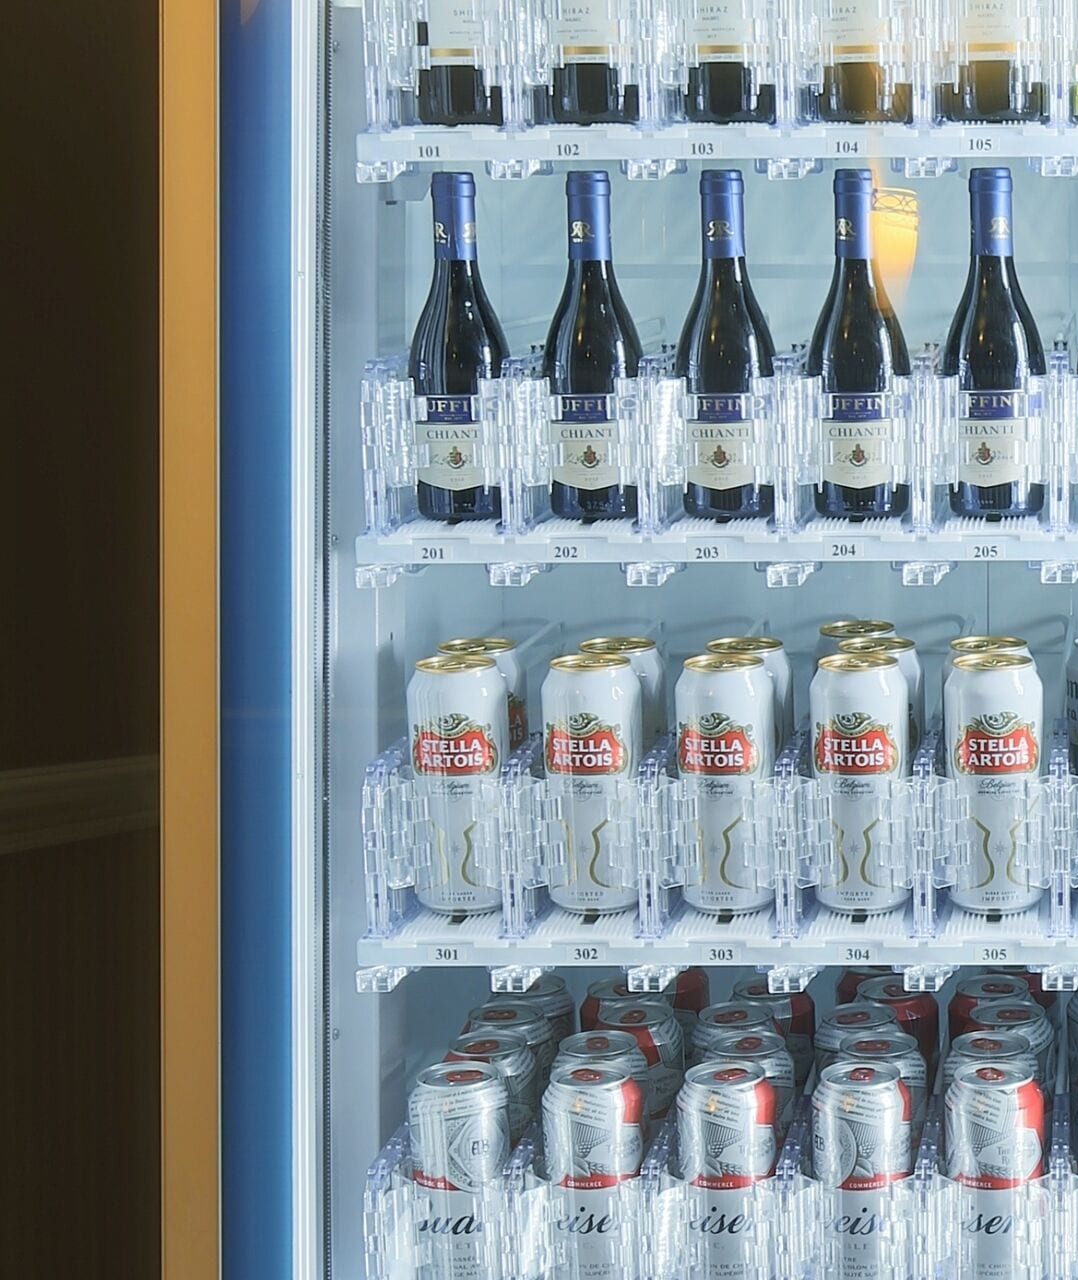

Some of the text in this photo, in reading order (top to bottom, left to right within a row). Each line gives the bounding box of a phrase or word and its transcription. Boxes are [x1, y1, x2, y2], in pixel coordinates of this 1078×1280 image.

[557, 143, 580, 156] 102
[692, 142, 714, 155] 103
[836, 141, 858, 153] 104
[970, 138, 992, 151] 105
[418, 146, 441, 158] 101
[427, 429, 479, 439] CHIANT
[561, 429, 614, 439] CHIANT
[422, 547, 444, 560] 201
[554, 546, 578, 558] 202
[695, 546, 719, 560] 203
[832, 544, 856, 556] 204
[974, 545, 998, 558] 205
[421, 739, 482, 752] STELLA
[552, 738, 612, 751] STELLA
[684, 738, 744, 751] STELLA
[823, 738, 883, 751] STELLA
[969, 738, 1028, 751] STELLA
[421, 754, 484, 767] ARTOIS
[552, 753, 613, 767] ARTOIS
[684, 753, 745, 767] ARTOIS
[823, 753, 885, 767] ARTOIS
[968, 752, 1029, 767] ARTOIS
[435, 948, 458, 960] 301
[574, 948, 598, 960] 302
[711, 948, 733, 961] 303
[847, 948, 870, 961] 304
[984, 948, 1007, 961] 305
